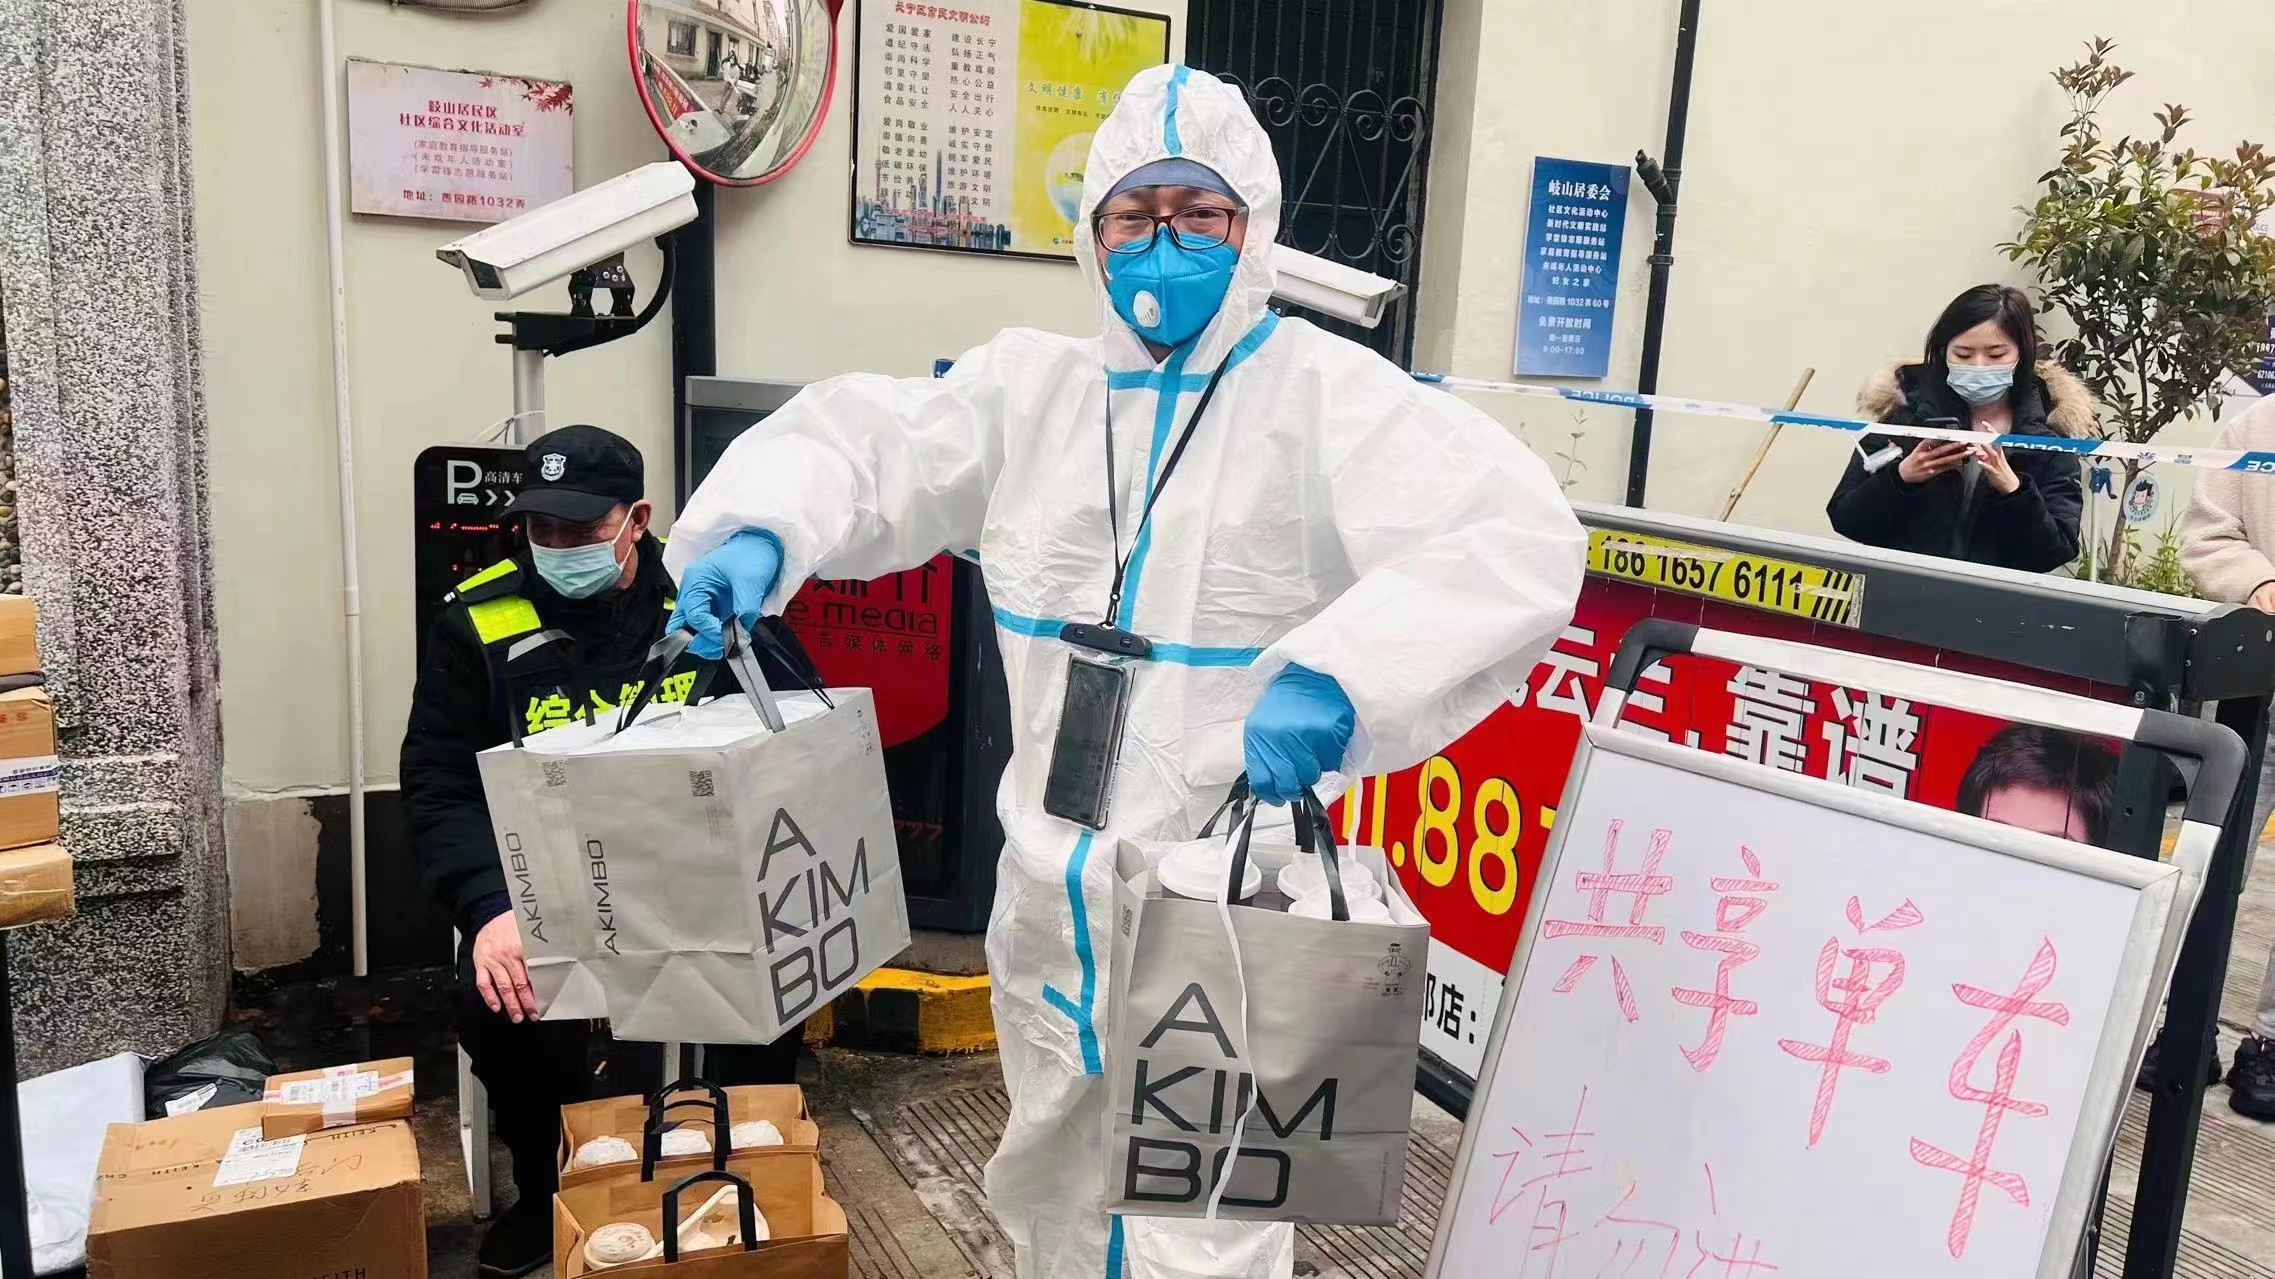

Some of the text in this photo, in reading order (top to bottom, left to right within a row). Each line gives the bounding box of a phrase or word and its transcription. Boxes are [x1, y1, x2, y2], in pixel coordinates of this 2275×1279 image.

[885, 23, 932, 38] 爱国爱家
[951, 33, 997, 48] 建设长宁
[951, 47, 997, 62] 弘扬正气
[884, 65, 930, 81] 邻里守望
[950, 75, 995, 90] 热心公益
[883, 94, 929, 109] 食品安全
[949, 89, 994, 104] 安全出行
[948, 103, 994, 117] 人人关心
[400, 113, 526, 137] 社区综合文化活动室
[882, 117, 928, 131] 爱岗敬业
[948, 125, 993, 139] 维护安定
[881, 145, 928, 159] 敬老爱幼
[1548, 179, 1612, 202] 岐山居委会
[1548, 204, 1609, 219] 社区文化活动中心
[1546, 218, 1607, 233] 新时代文明实践站
[1542, 261, 1602, 275] 未成年人活动中心
[1551, 276, 1591, 288] 妇女之家
[1539, 316, 1592, 330] 免费开放时间
[1601, 535, 1804, 610] 186 1657 6111
[757, 806, 818, 883] A
[505, 831, 548, 944] AKIMBO
[587, 838, 621, 956] AKIMBO
[758, 836, 871, 955] KIM
[768, 916, 860, 1027] BO
[1138, 981, 1239, 1060] A
[1131, 1058, 1339, 1142] KIM
[1124, 1135, 1292, 1209] BO
